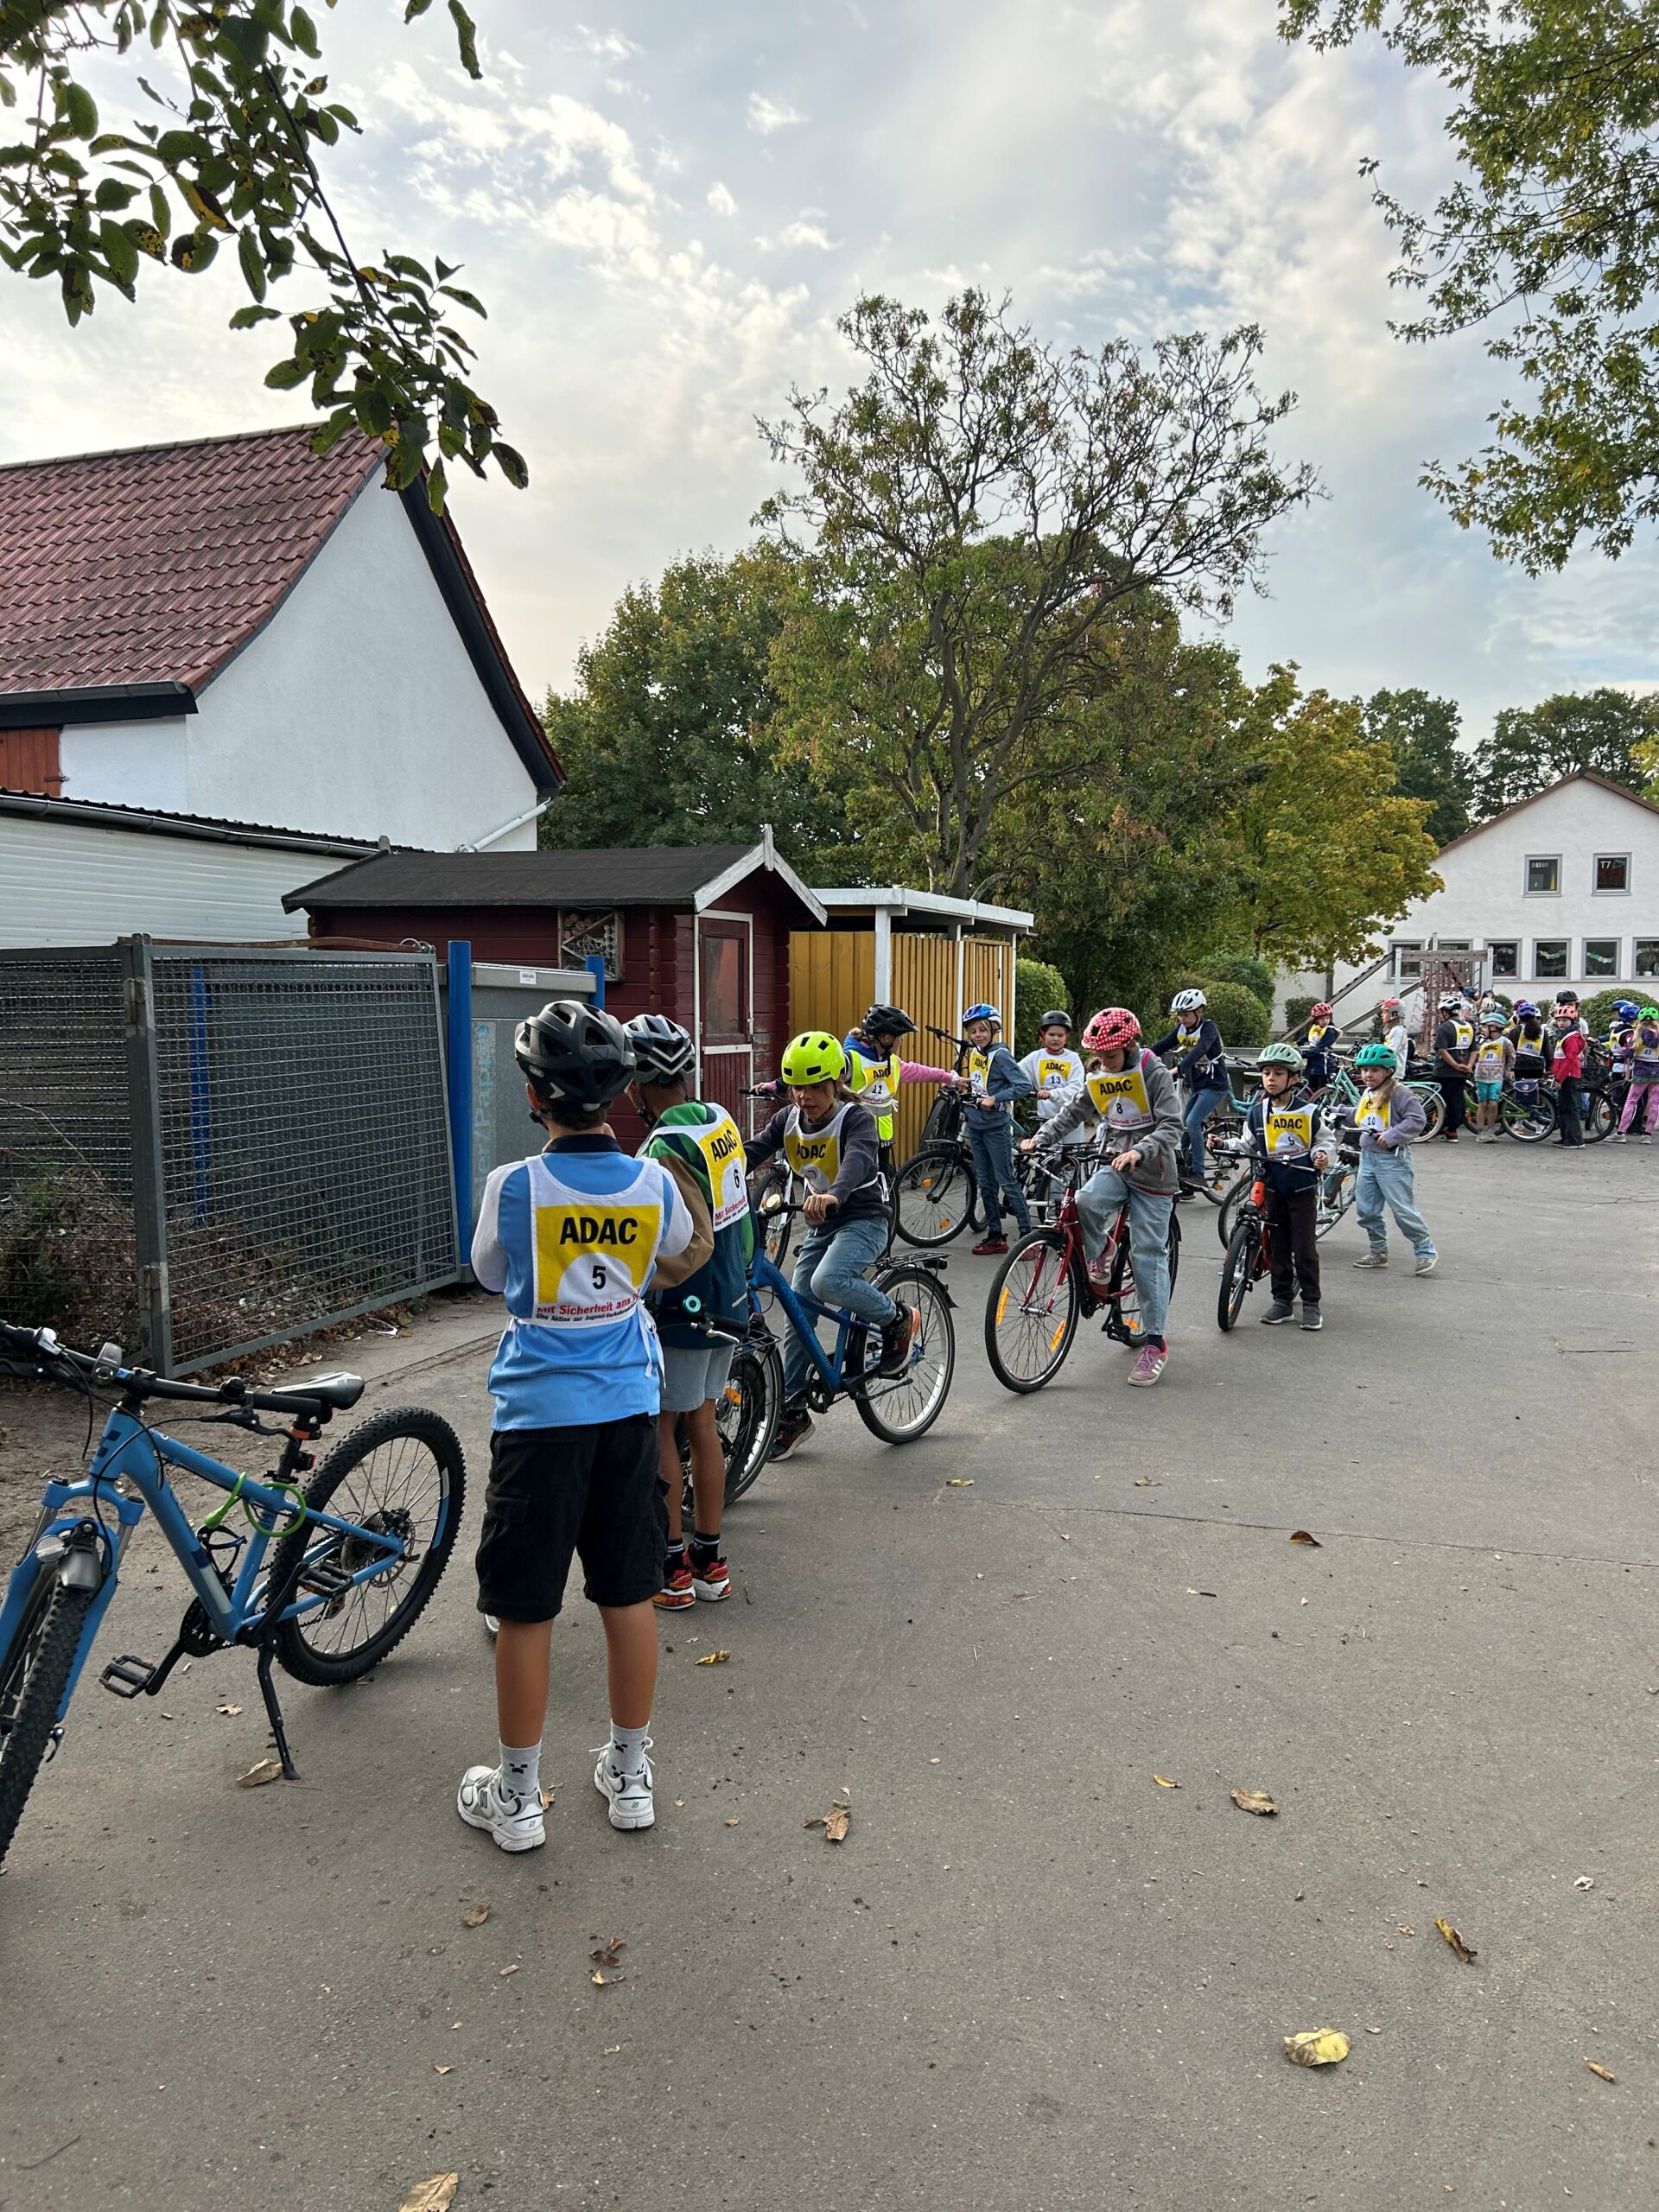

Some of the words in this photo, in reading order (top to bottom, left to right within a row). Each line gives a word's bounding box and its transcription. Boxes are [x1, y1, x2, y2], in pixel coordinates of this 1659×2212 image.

[1045, 1062, 1065, 1071] ADAC
[1051, 1076, 1061, 1084] 13
[1099, 1079, 1133, 1096] ADAC
[872, 1084, 882, 1094] 11
[1116, 1103, 1123, 1115] 8
[1274, 1118, 1303, 1129] ADAC
[1367, 1116, 1376, 1126] 10
[710, 1128, 737, 1163] ADAC
[796, 1142, 826, 1160] ADAC
[734, 1168, 740, 1189] 6
[560, 1217, 638, 1245] ADAC
[592, 1264, 607, 1290] 5
[559, 1301, 613, 1315] Sicherheit
[616, 1297, 631, 1309] ans
